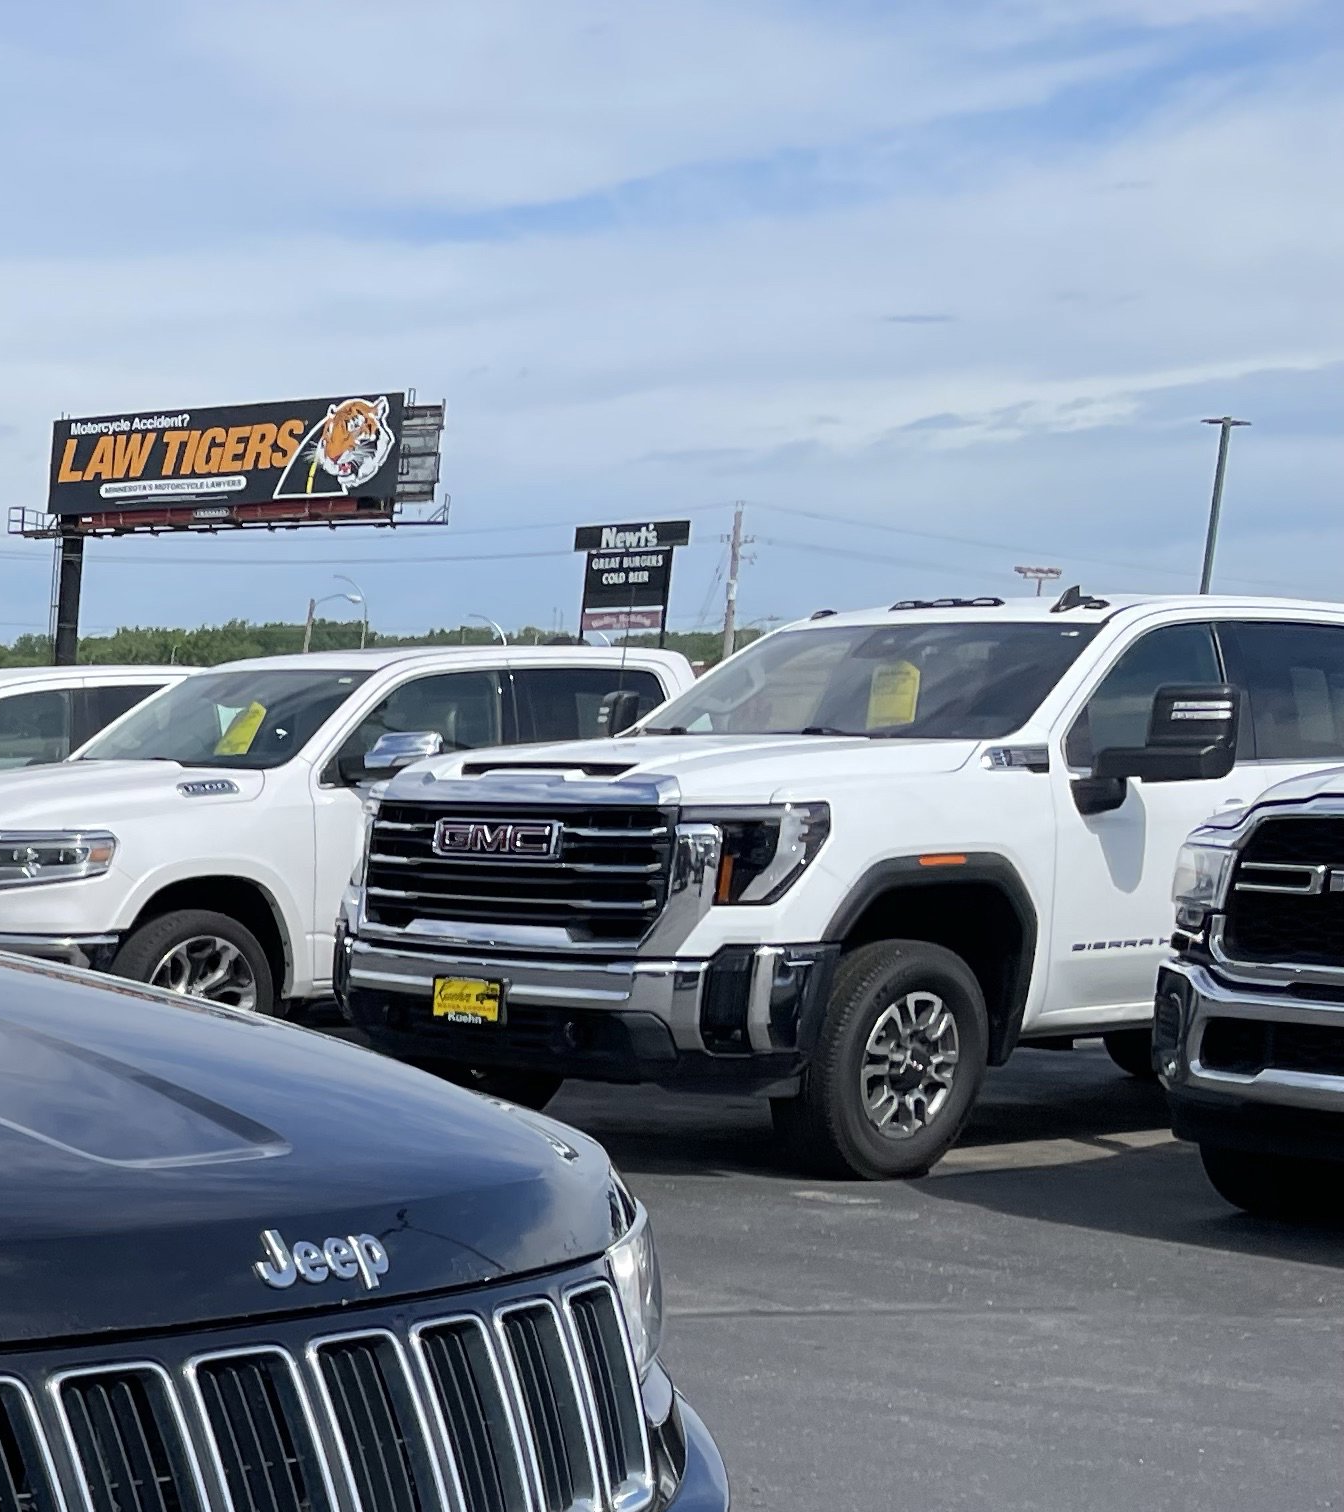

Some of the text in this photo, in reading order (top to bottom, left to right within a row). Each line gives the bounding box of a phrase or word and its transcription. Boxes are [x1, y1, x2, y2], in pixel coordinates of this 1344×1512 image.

[70, 413, 191, 436] Motorcycle Accident?
[57, 419, 305, 484] LAW TIGERS
[601, 523, 658, 548] Newt's
[591, 556, 621, 570] GREAT
[602, 571, 626, 585] COLD
[439, 824, 551, 852] GMC
[252, 1229, 390, 1290] Jeep
